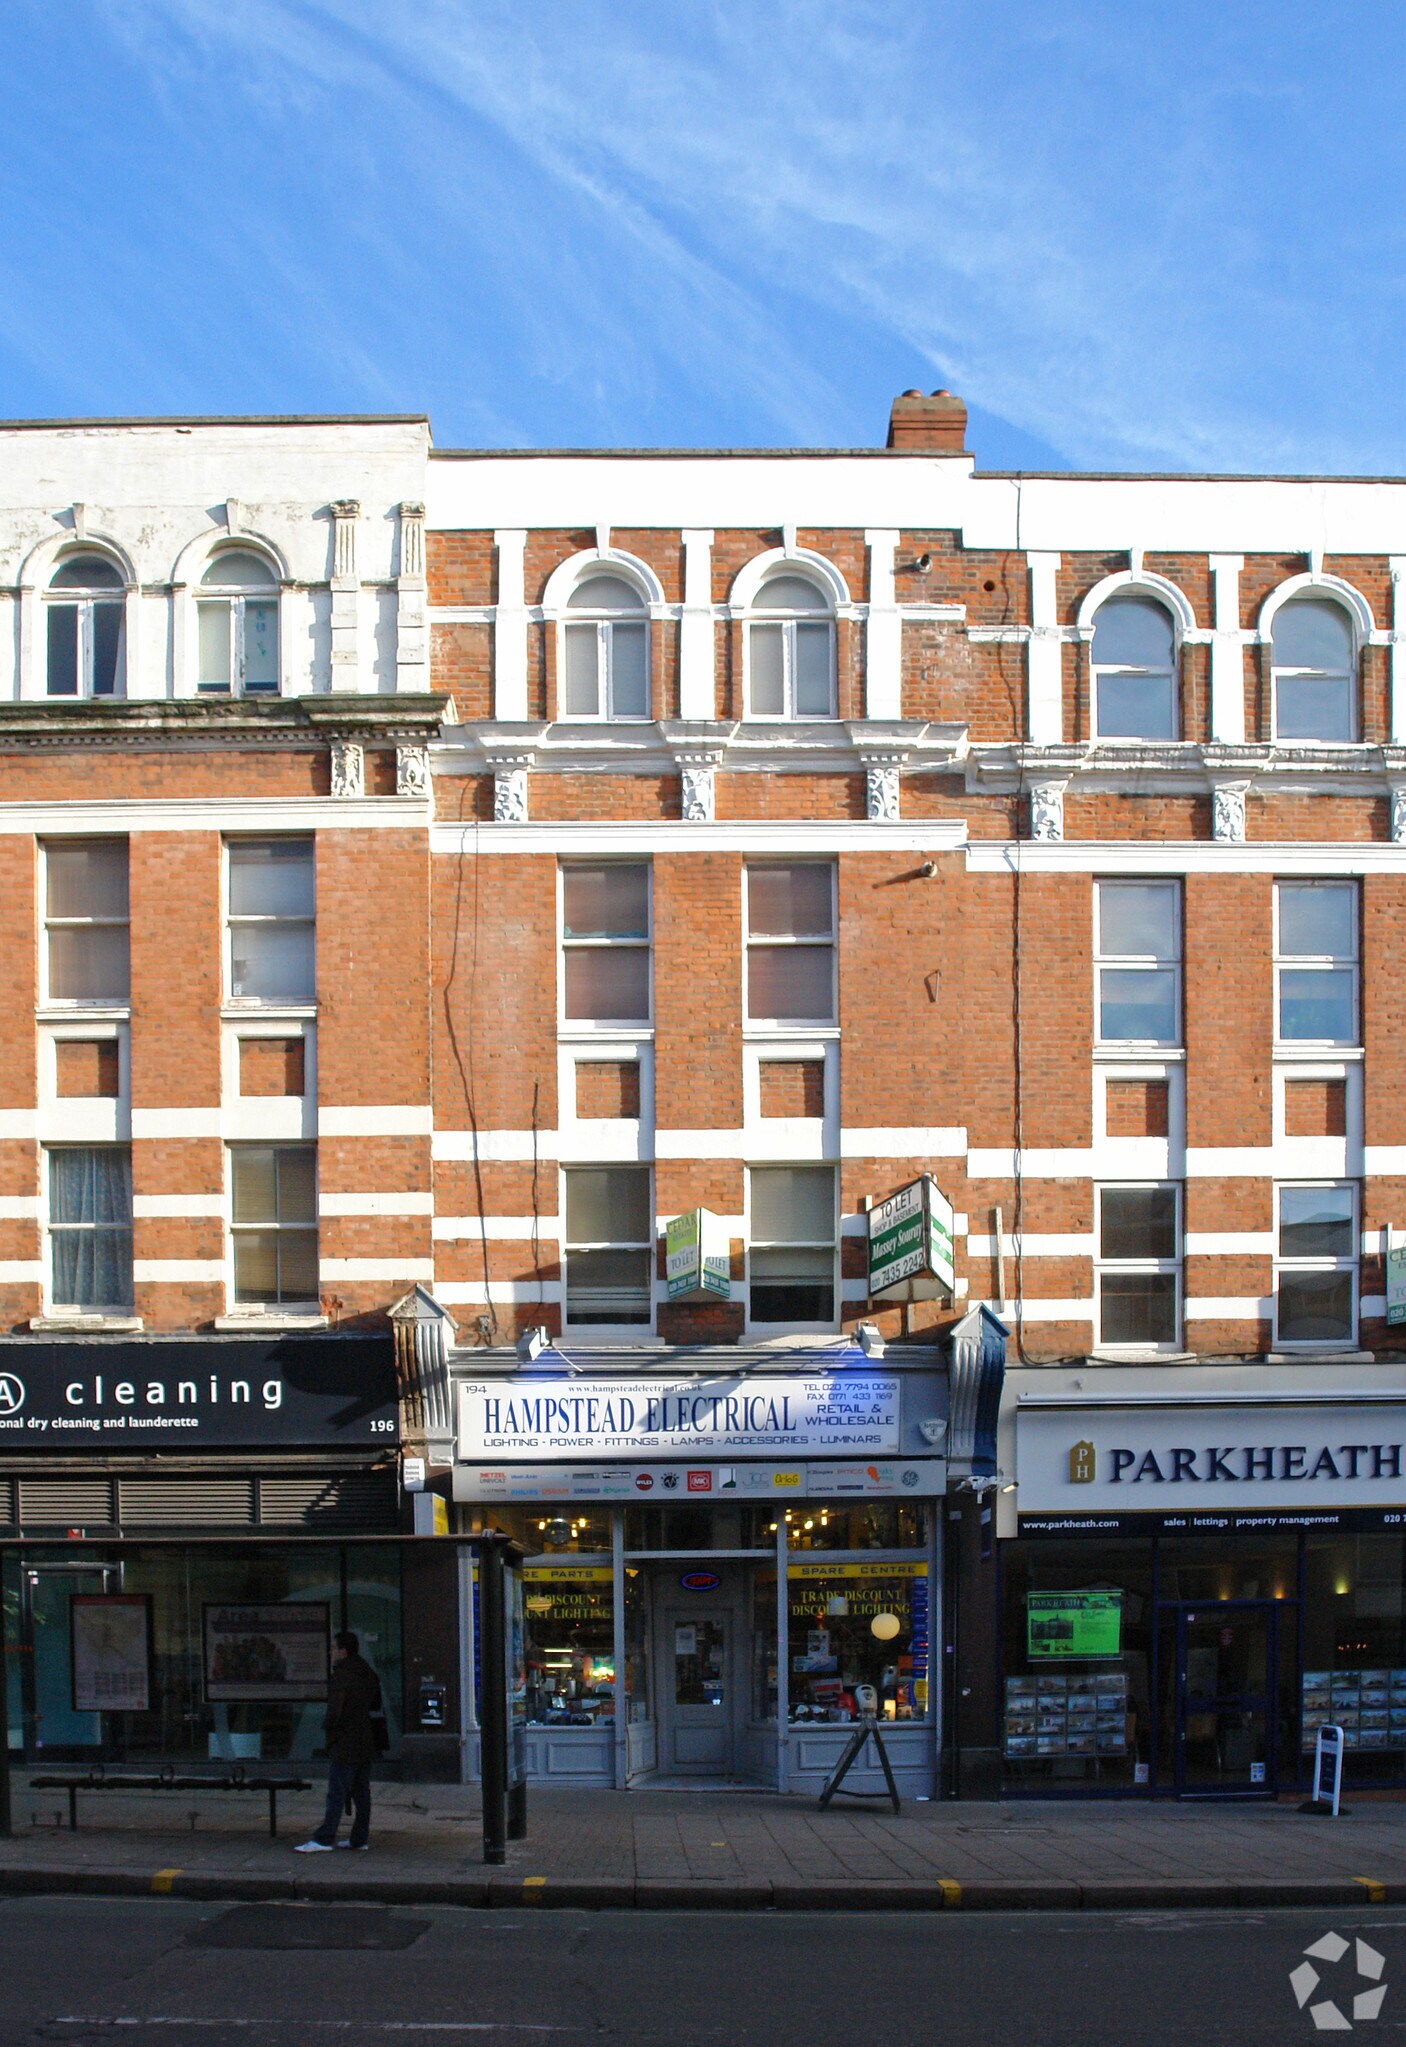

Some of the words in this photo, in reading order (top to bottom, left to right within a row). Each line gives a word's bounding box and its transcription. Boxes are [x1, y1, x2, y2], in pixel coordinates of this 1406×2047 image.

[880, 1203, 893, 1219] TO
[896, 1189, 912, 1211] LET
[667, 1212, 697, 1235] CEDAR
[875, 1222, 888, 1234] SHOP
[893, 1204, 919, 1223] BASEMENT
[671, 1258, 681, 1271] TO
[683, 1251, 694, 1266] LET
[715, 1256, 726, 1271] LET
[881, 1264, 901, 1286] 7435
[903, 1253, 924, 1275] 2242
[65, 1374, 282, 1409] cleaning
[465, 1385, 487, 1394] 194
[845, 1383, 869, 1391] 7794
[872, 1383, 898, 1391] 0065
[828, 1393, 848, 1401] 0171
[852, 1393, 871, 1401] 433
[875, 1393, 893, 1401] 1169
[484, 1398, 635, 1434] HAMPSTEAD
[646, 1396, 796, 1432] ELECTRICAL
[817, 1404, 865, 1414] RETAIL
[871, 1404, 882, 1414] &
[27, 1417, 49, 1431] dry
[51, 1417, 101, 1430] cleaning
[103, 1417, 125, 1428] and
[128, 1416, 199, 1428] launderette
[370, 1420, 394, 1432] 196
[805, 1416, 894, 1426] WHOLESALE
[483, 1438, 539, 1447] LIGHTING
[549, 1438, 594, 1446] POWER
[604, 1438, 659, 1446] FITTINGS
[671, 1437, 714, 1446] LAMPS
[724, 1436, 808, 1445] ACCESSORIES
[820, 1435, 882, 1444] LUMINARS
[1108, 1445, 1403, 1483] PARKHEATH
[1164, 1518, 1186, 1526] sales
[1194, 1517, 1228, 1527] lettings
[1236, 1517, 1277, 1526] property
[1279, 1515, 1339, 1525] management
[1384, 1514, 1400, 1522] 020
[1023, 1520, 1119, 1530] www.parkheath.com
[551, 1570, 593, 1578] PARTS
[802, 1567, 845, 1575] SPARE
[860, 1566, 915, 1574] CENTRE
[844, 1589, 900, 1601] DISCOUNT
[553, 1607, 611, 1619] LIGHTING
[853, 1604, 910, 1615] LIGHTING
